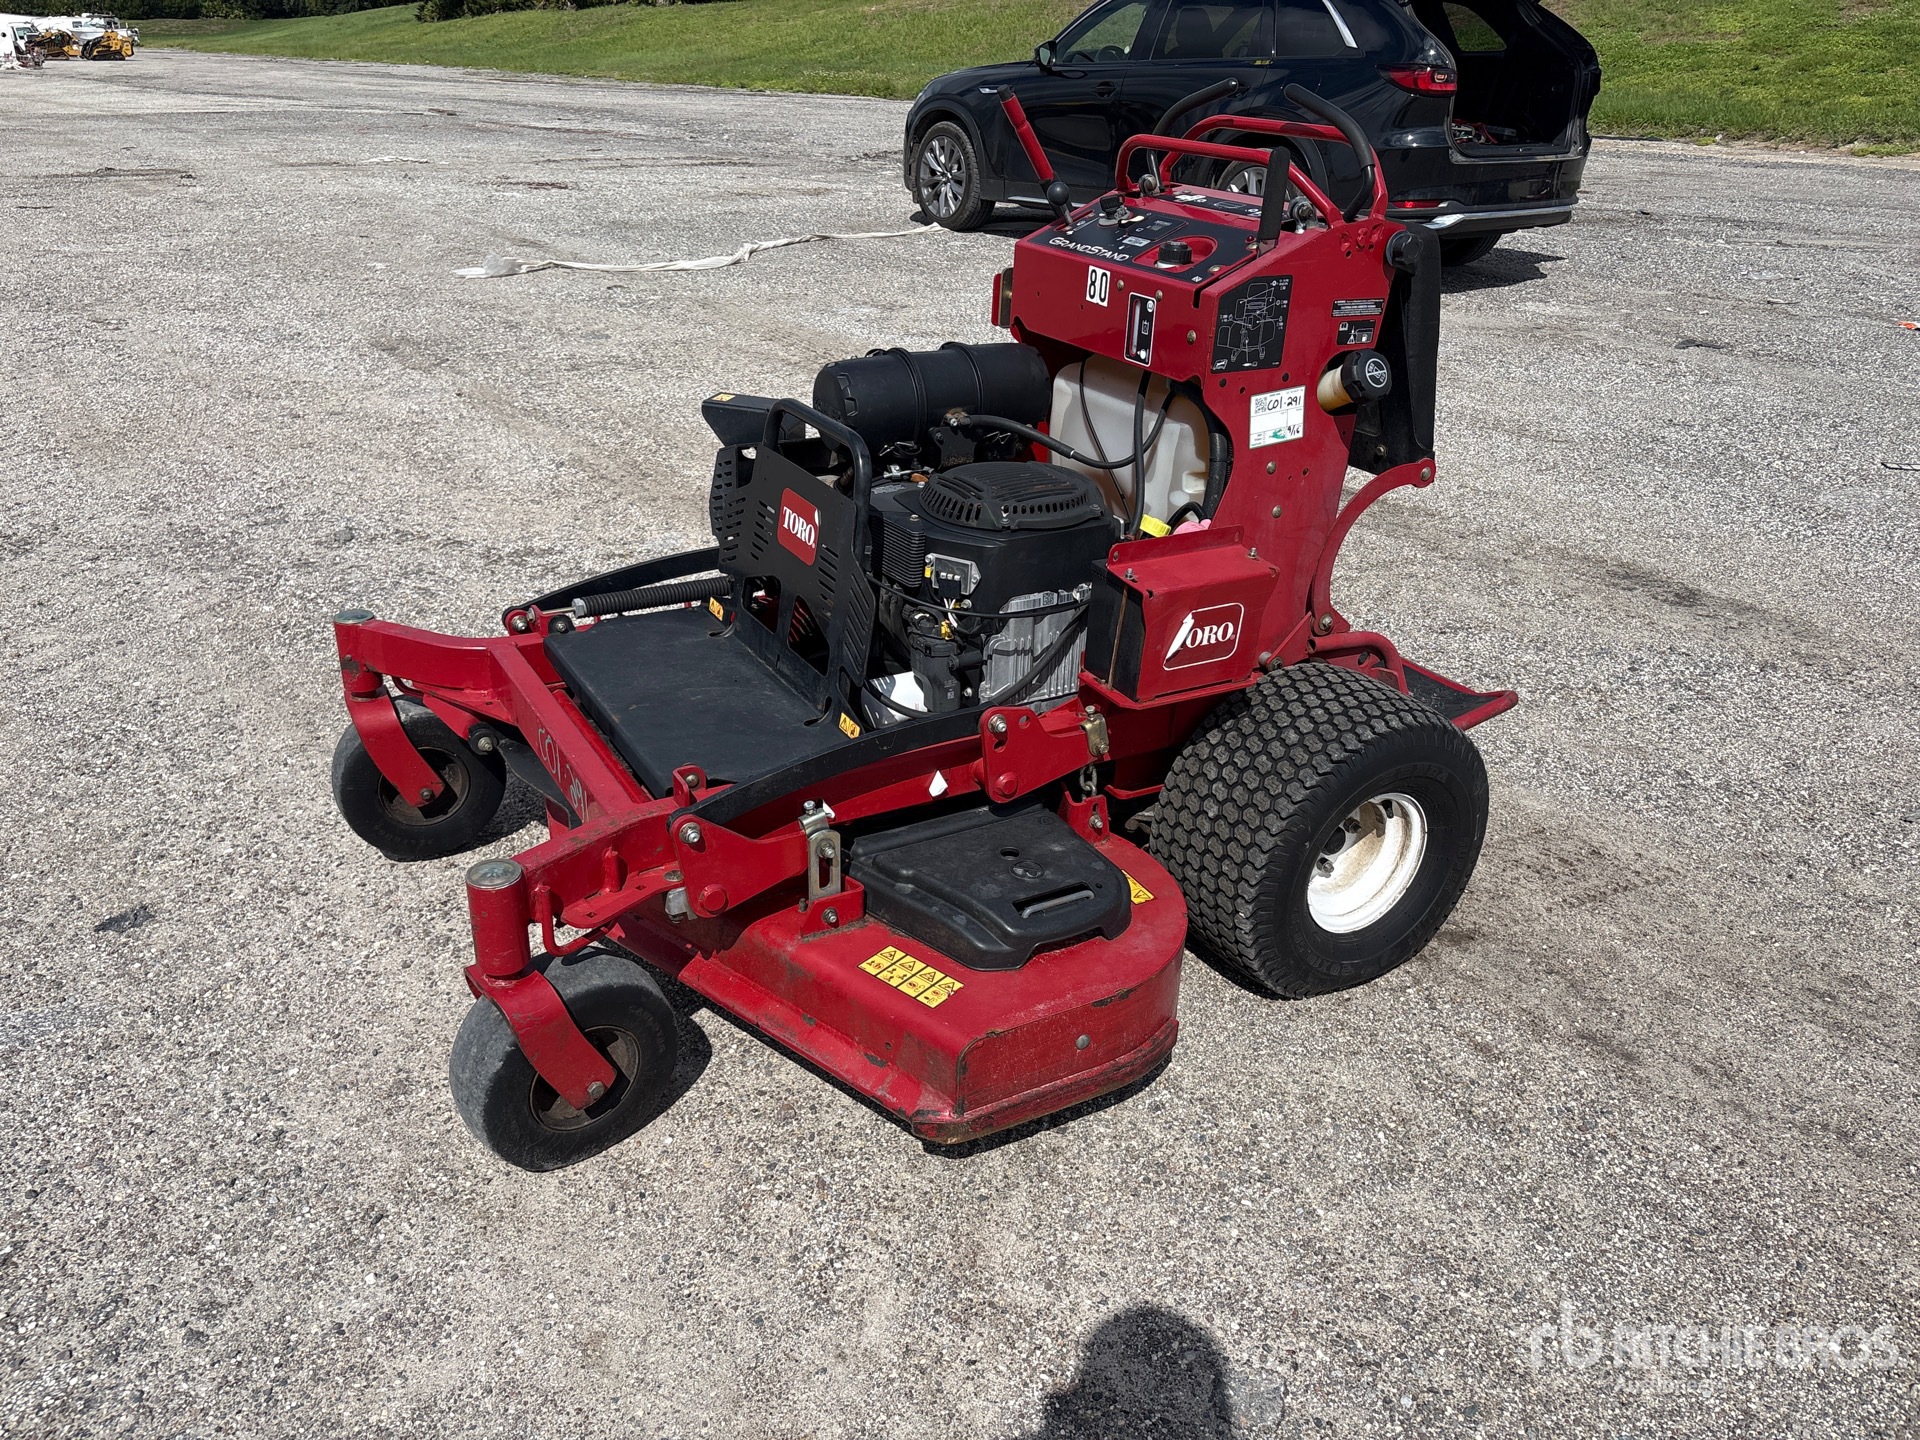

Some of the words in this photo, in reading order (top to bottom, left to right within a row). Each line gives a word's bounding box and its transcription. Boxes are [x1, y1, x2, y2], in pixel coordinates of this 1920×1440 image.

[1088, 269, 1109, 303] 80
[783, 506, 815, 546] TORO
[1178, 621, 1234, 649] ORO
